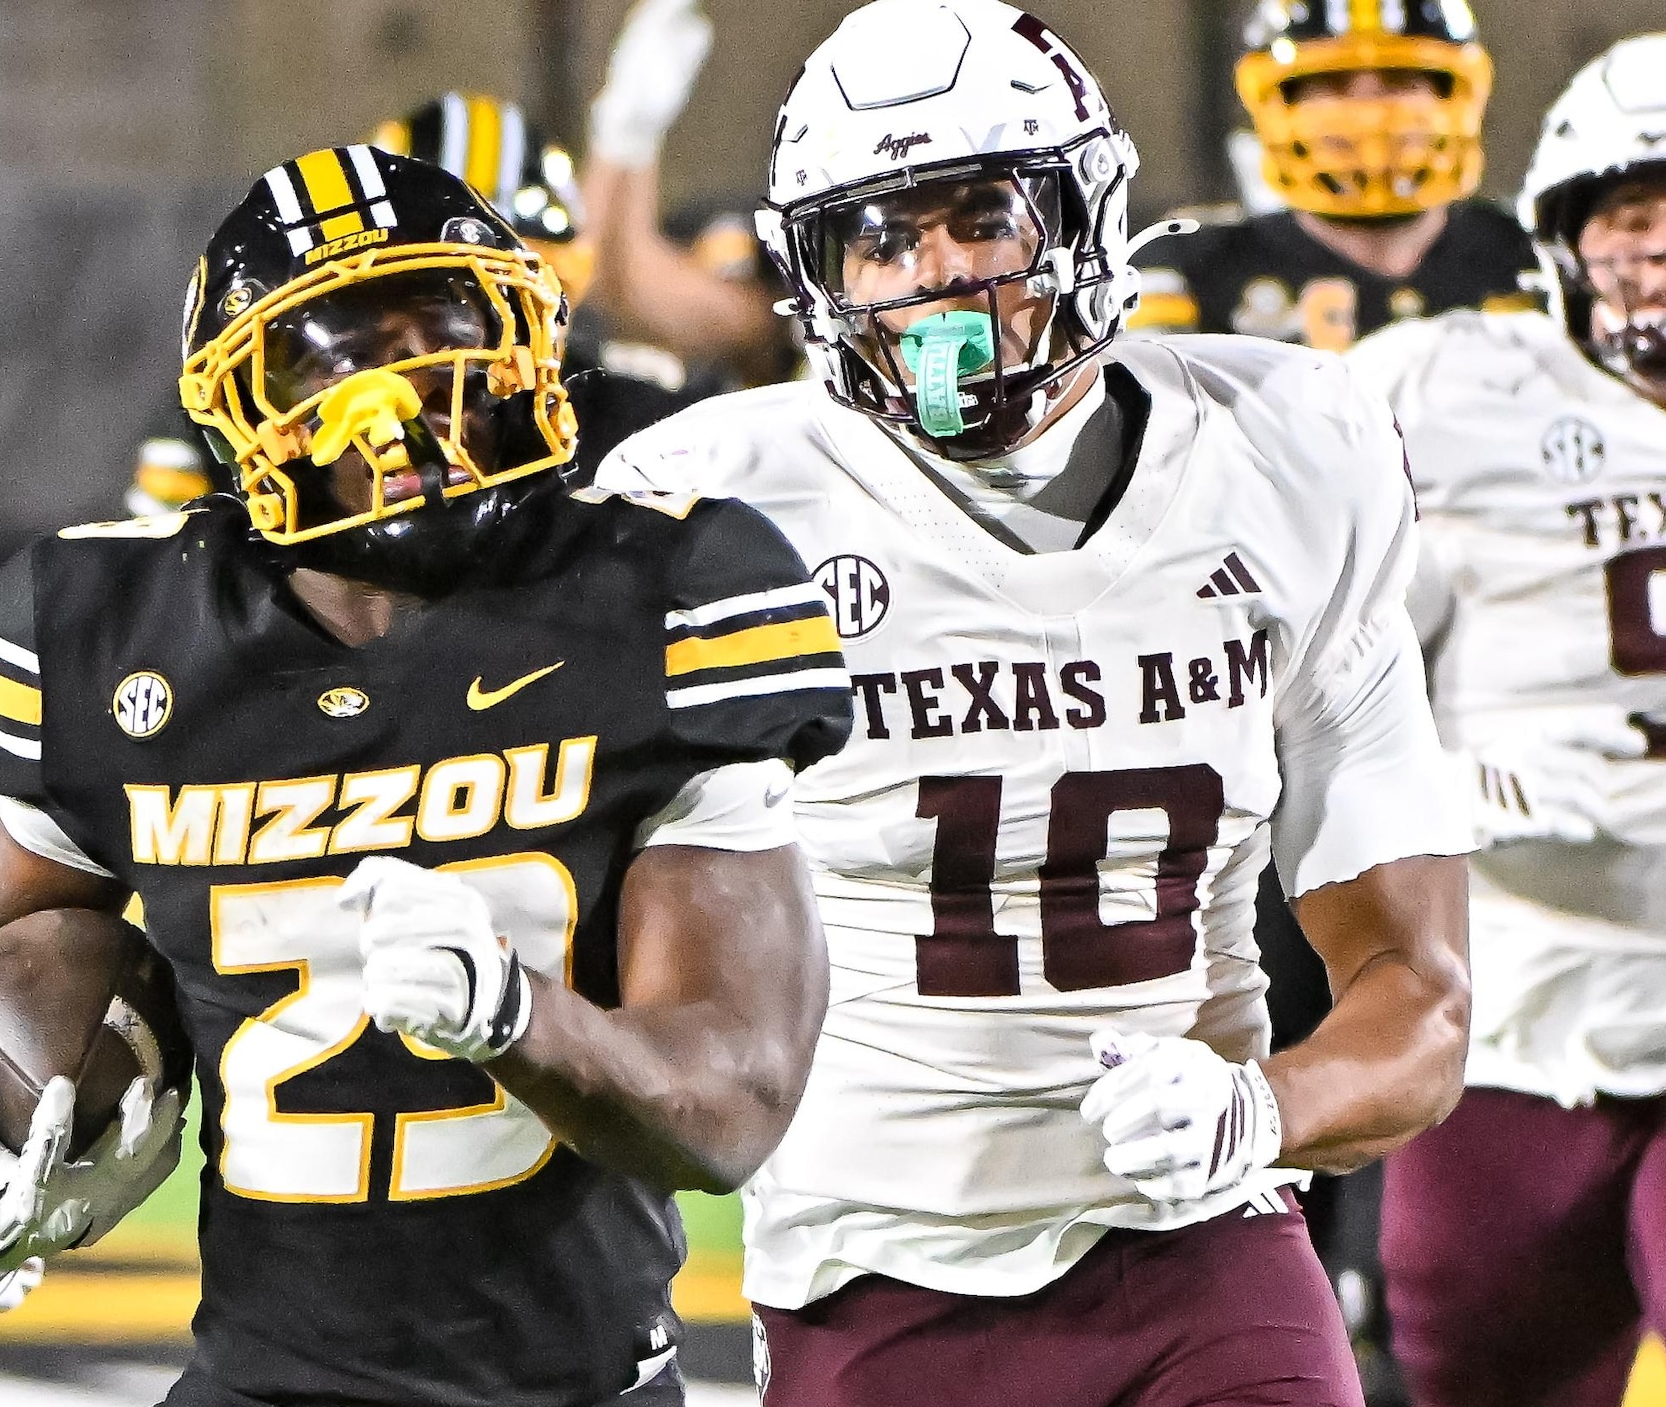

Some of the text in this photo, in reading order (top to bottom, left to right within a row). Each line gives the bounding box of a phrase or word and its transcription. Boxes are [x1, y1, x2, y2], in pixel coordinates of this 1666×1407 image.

[873, 132, 933, 161] Aggies
[305, 227, 389, 266] MIZZOU
[114, 672, 174, 738] SEC
[851, 628, 1274, 741] TEXAS A&M
[123, 735, 598, 867] MIZZOU
[914, 762, 1224, 997] 10
